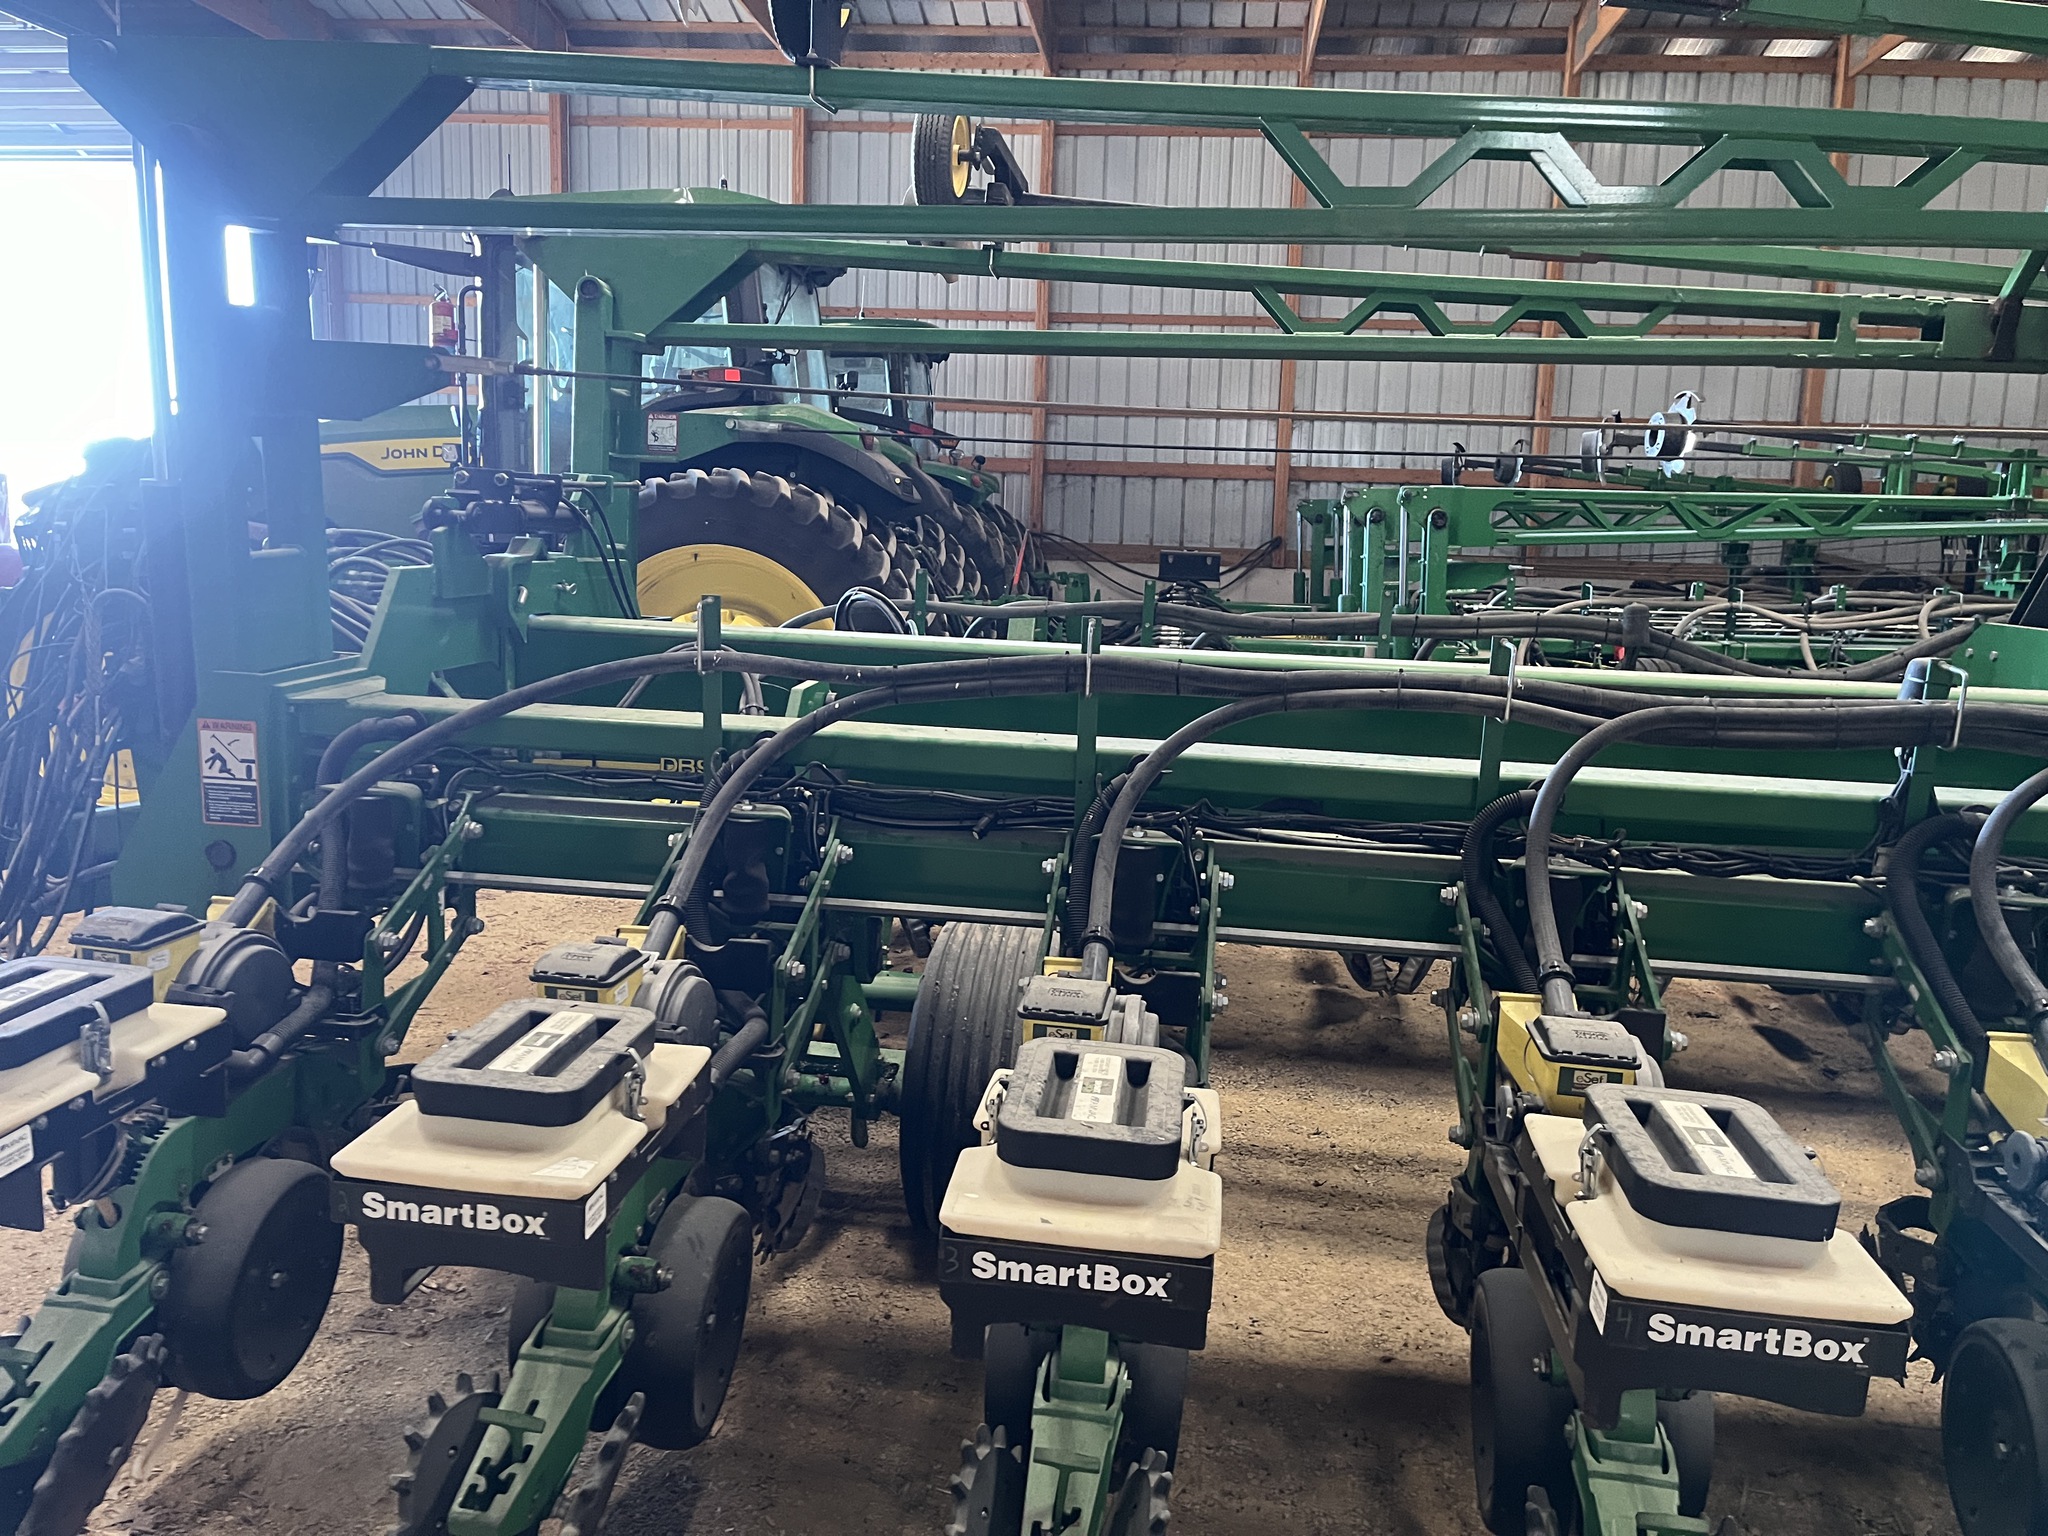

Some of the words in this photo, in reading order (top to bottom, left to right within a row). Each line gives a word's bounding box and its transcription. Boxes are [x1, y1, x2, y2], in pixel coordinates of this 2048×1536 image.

[381, 447, 428, 460] JOHN
[432, 445, 443, 458] D
[1048, 1028, 1075, 1039] eSet
[1576, 1072, 1605, 1084] eSet
[362, 1191, 547, 1237] SmartBox
[971, 1251, 1169, 1298] SmartBox
[1647, 1313, 1867, 1364] SmartBox
